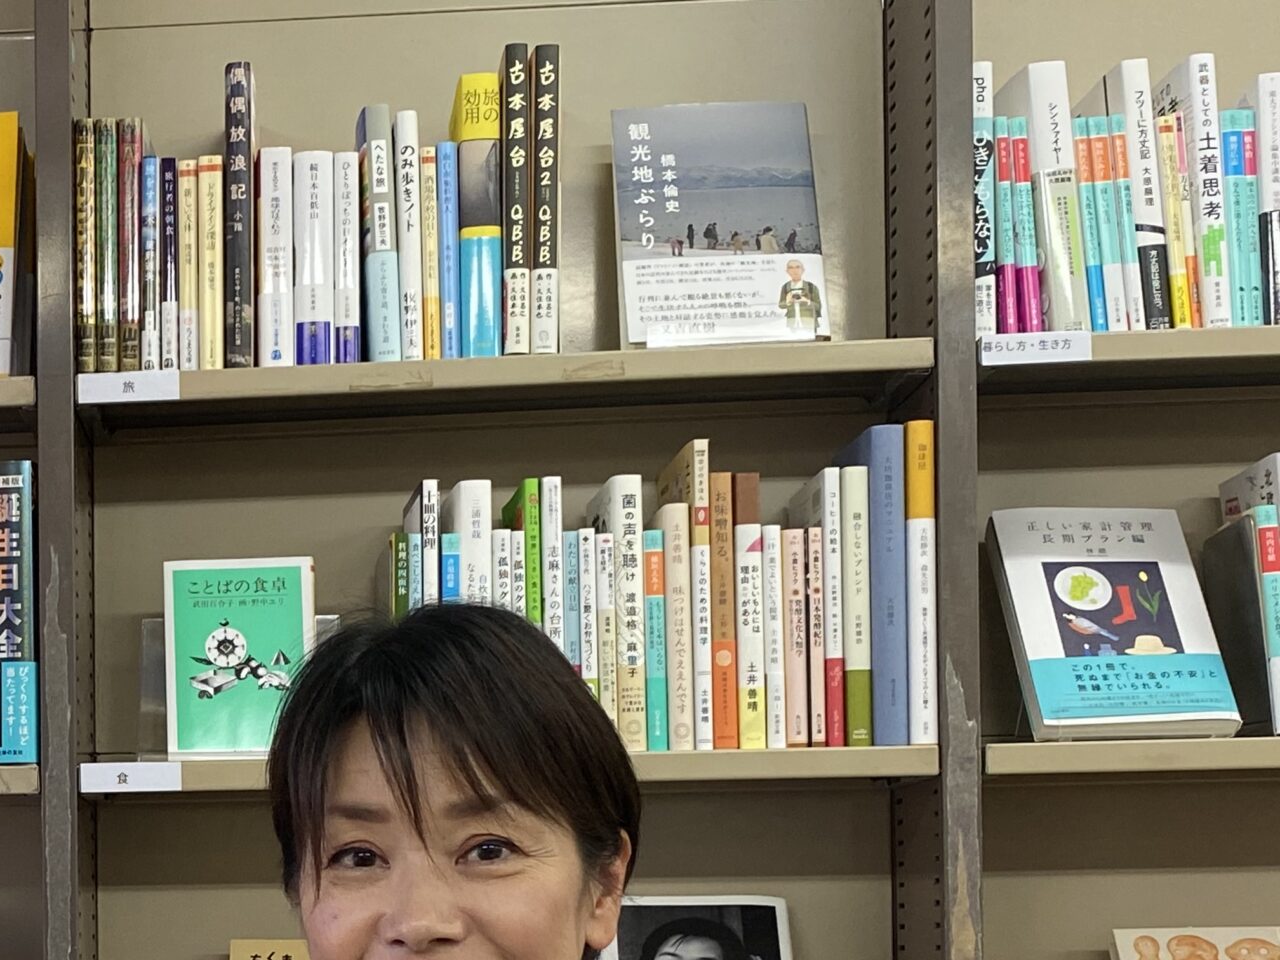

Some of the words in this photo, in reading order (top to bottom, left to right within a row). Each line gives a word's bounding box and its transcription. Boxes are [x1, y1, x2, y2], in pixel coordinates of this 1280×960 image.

[463, 89, 480, 124] 効用
[483, 88, 500, 124] 旅の
[508, 60, 526, 168] 古本屋台
[973, 76, 985, 103] pha
[229, 67, 247, 200] 偶偶放浪記
[538, 60, 556, 186] 古本屋台2
[1047, 102, 1061, 165] シン・ファイヤー
[1134, 89, 1151, 160] フツーに方丈記
[1197, 62, 1223, 222] 武器としての土着思考
[374, 144, 387, 187] へたな旅
[401, 145, 415, 233] のみ歩きノート
[627, 123, 656, 250] 観光地ぶらり
[660, 153, 681, 213] 橋本倫史
[973, 130, 992, 253] ひきこもらない
[981, 338, 1073, 353] 暮らし方・生き方
[122, 380, 136, 394] 旅
[424, 490, 436, 550] 十皿の料理
[621, 493, 638, 582] 菌の声を聴け
[672, 523, 683, 565] 土井善晴
[829, 491, 838, 554] コーヒーの絵本
[1026, 520, 1156, 532] 正しい家計管理
[1041, 533, 1146, 545] 長期プラン編
[568, 542, 578, 612] わたしの献立日記
[791, 551, 799, 585] 小倉ヒラク
[812, 550, 820, 583] 小倉ヒラク
[852, 511, 863, 596] 融合しないブレンド
[186, 576, 287, 596] ことばの食卓
[547, 545, 561, 639] 志麻さんの台所
[698, 550, 708, 646] くらしのための料理学
[750, 565, 761, 634] おいしいもんには
[583, 584, 593, 673] ハッと驚くお弁当づくり
[672, 586, 687, 714] 味つけはせんでええんです
[794, 598, 804, 658] 発酵文化人類学
[812, 597, 822, 648] 日本発酵紀行
[746, 662, 758, 712] 土井善晴
[1071, 662, 1136, 672] この1冊で、
[1074, 669, 1218, 682] 死ぬまで「お金の不安」と
[1077, 681, 1171, 693] 無縁でいられる。
[19, 666, 29, 746] びっくりするほど
[701, 689, 709, 723] 土井善晴
[116, 771, 129, 785] 食
